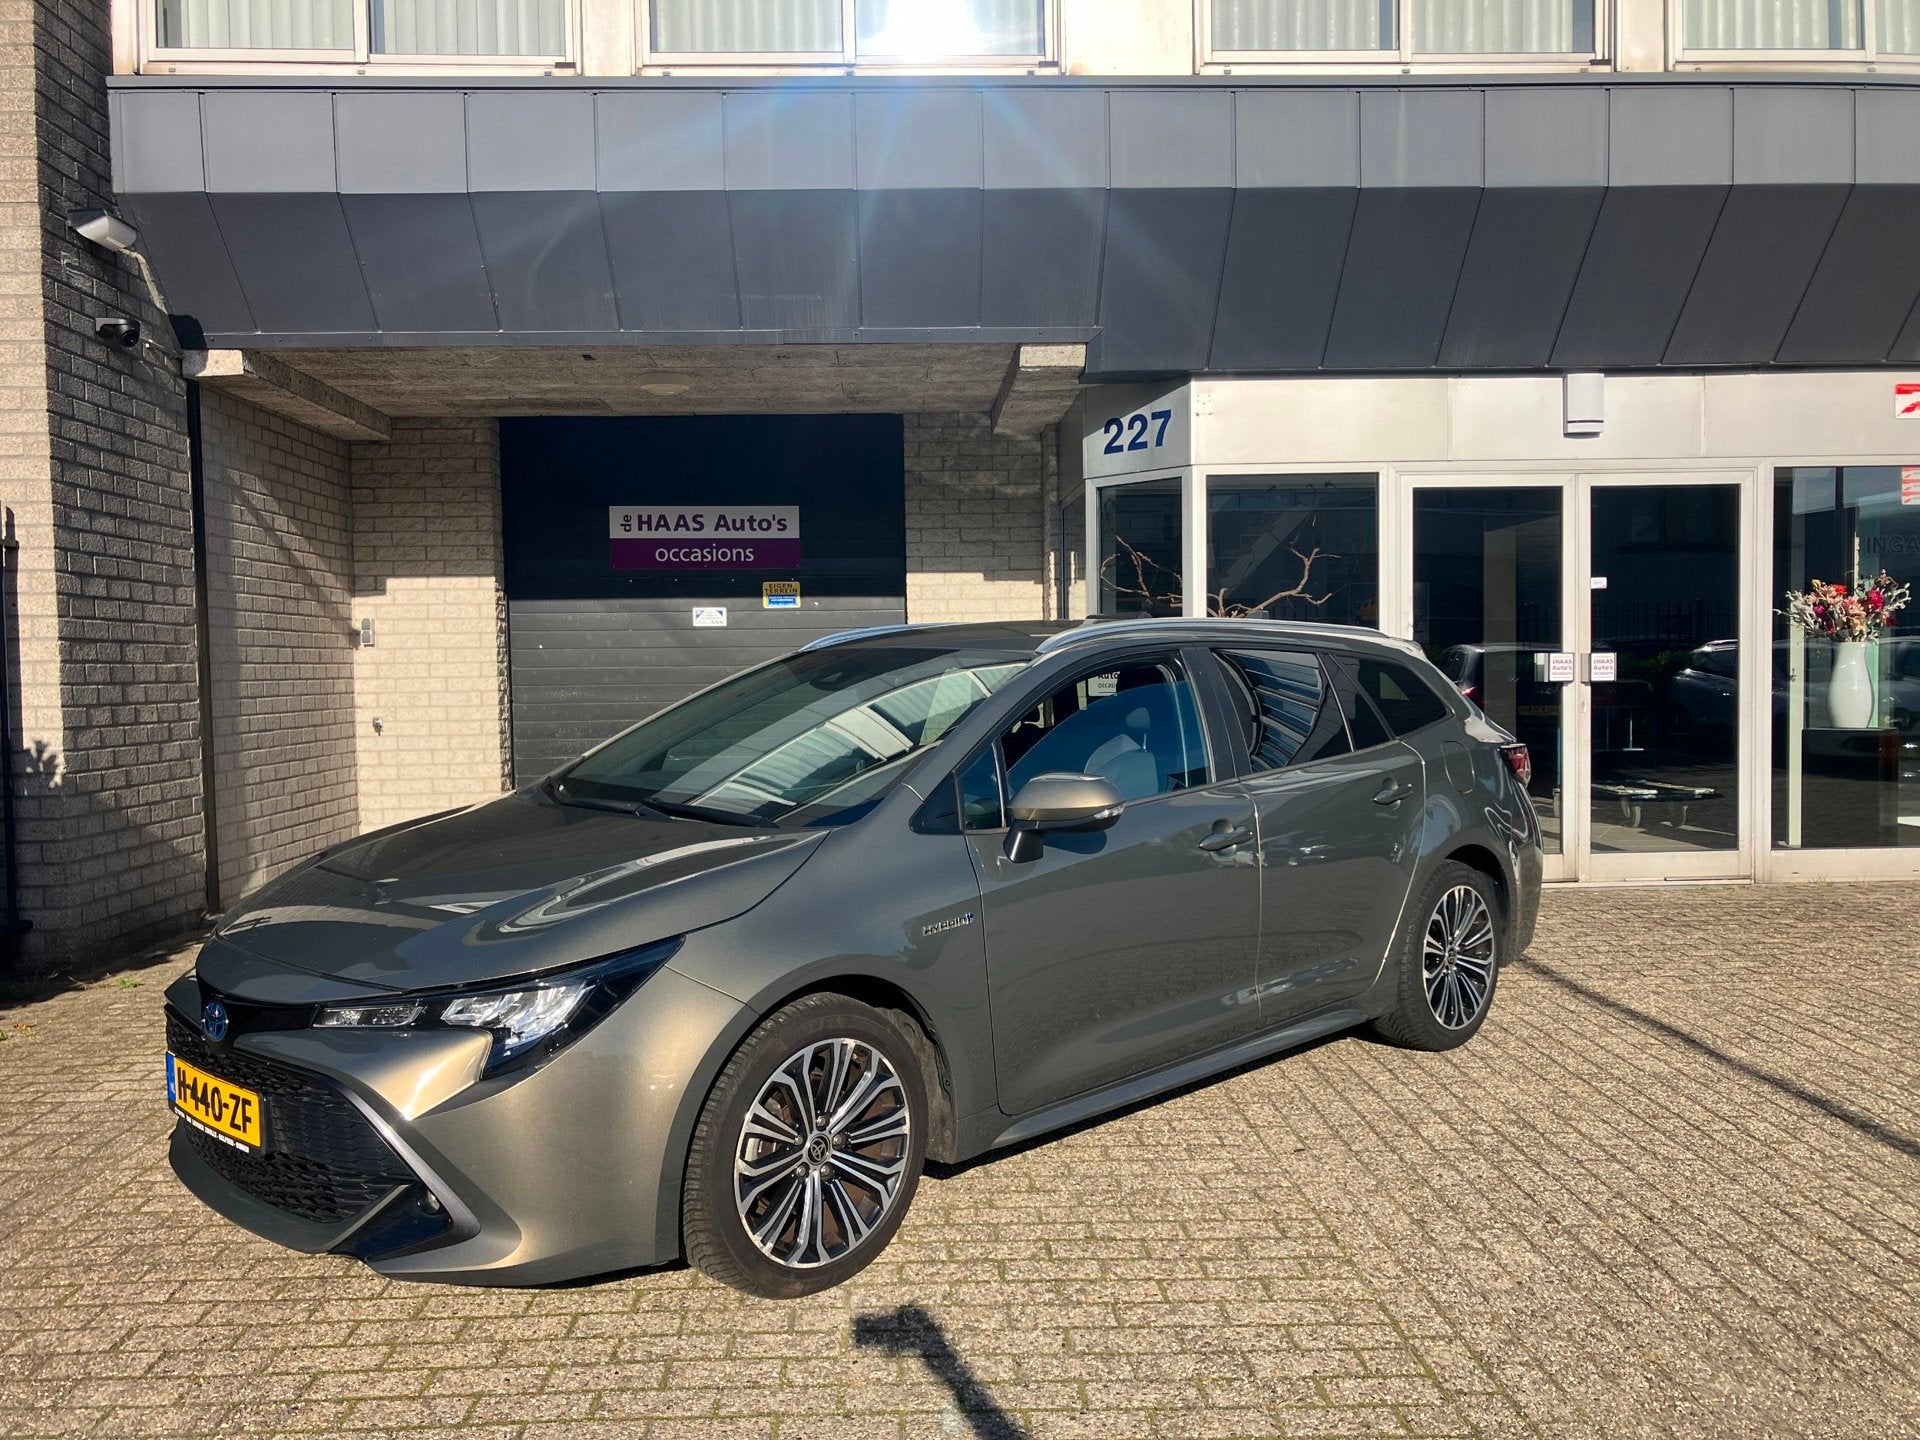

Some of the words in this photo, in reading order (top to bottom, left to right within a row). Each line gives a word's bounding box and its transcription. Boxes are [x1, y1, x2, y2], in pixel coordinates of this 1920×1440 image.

[1103, 409, 1172, 455] 227
[620, 514, 632, 532] de
[637, 514, 705, 532] HAAS
[714, 513, 788, 532] Auto's
[655, 543, 755, 562] occasions
[176, 1066, 252, 1133] H-440-ZF
